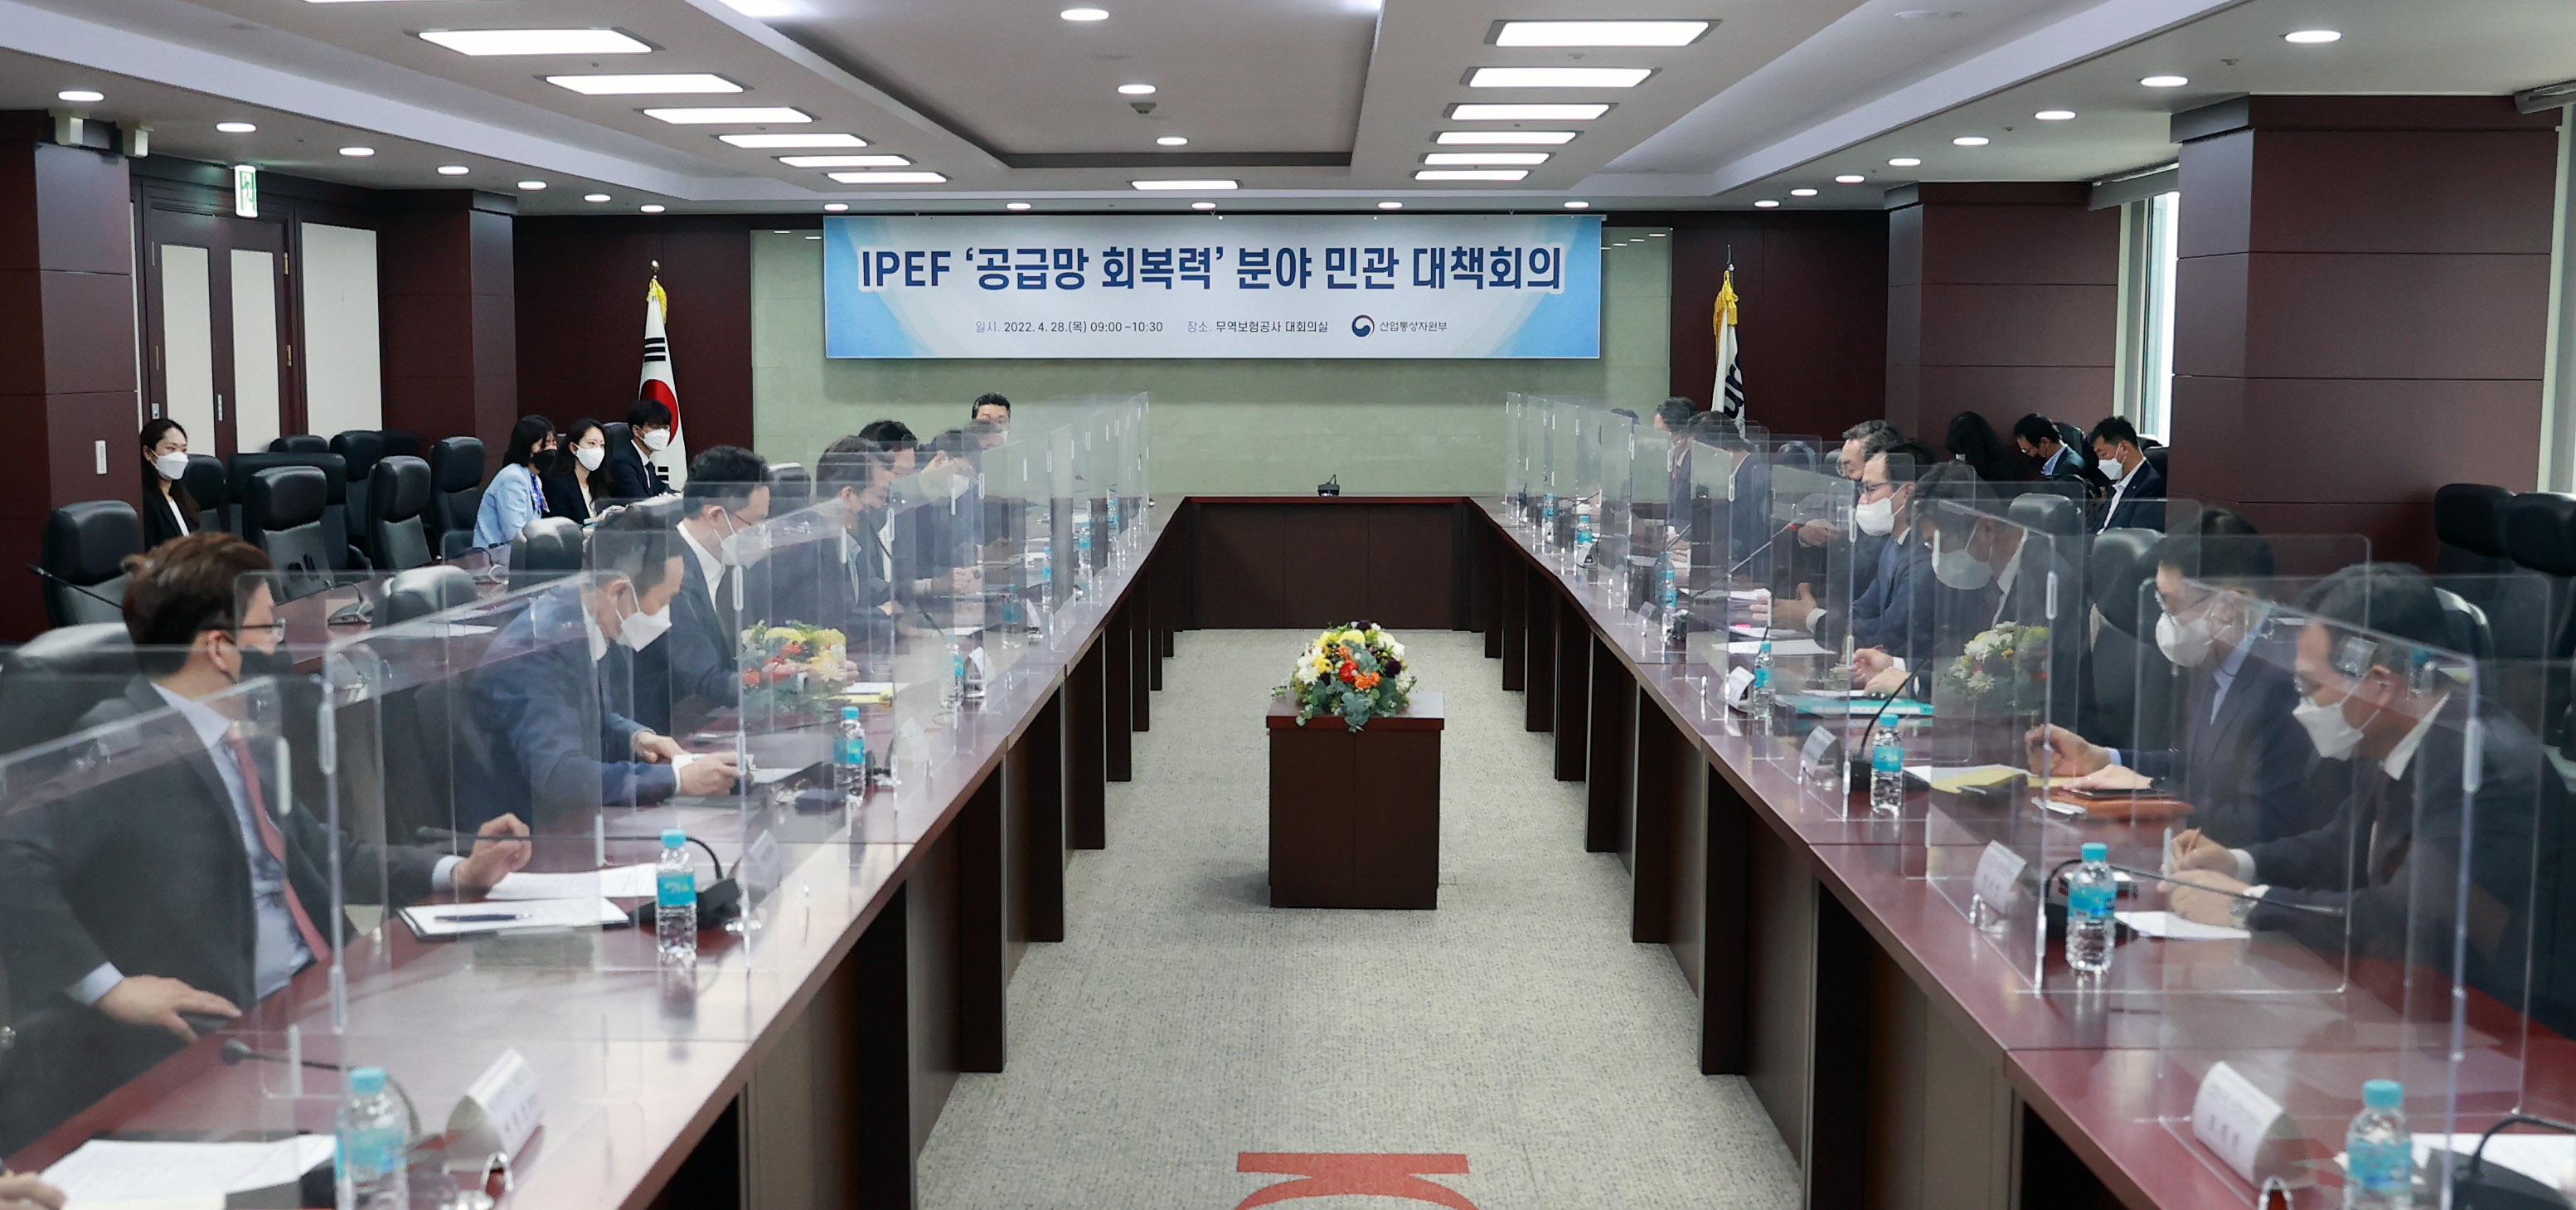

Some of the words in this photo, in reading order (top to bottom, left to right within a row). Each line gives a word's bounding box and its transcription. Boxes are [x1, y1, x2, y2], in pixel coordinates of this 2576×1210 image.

[862, 250, 952, 287] IPEF
[1236, 246, 1312, 289] 분야
[1325, 247, 1400, 289] 민관
[1413, 245, 1560, 290] 대책회의
[1003, 321, 1036, 333] 2022.
[1037, 322, 1048, 333] 4.
[1090, 321, 1123, 333] 09:00
[1215, 320, 1282, 333] 무역보험공사
[1285, 320, 1328, 333] 대회의실
[1380, 321, 1448, 333] 산업통상자원부
